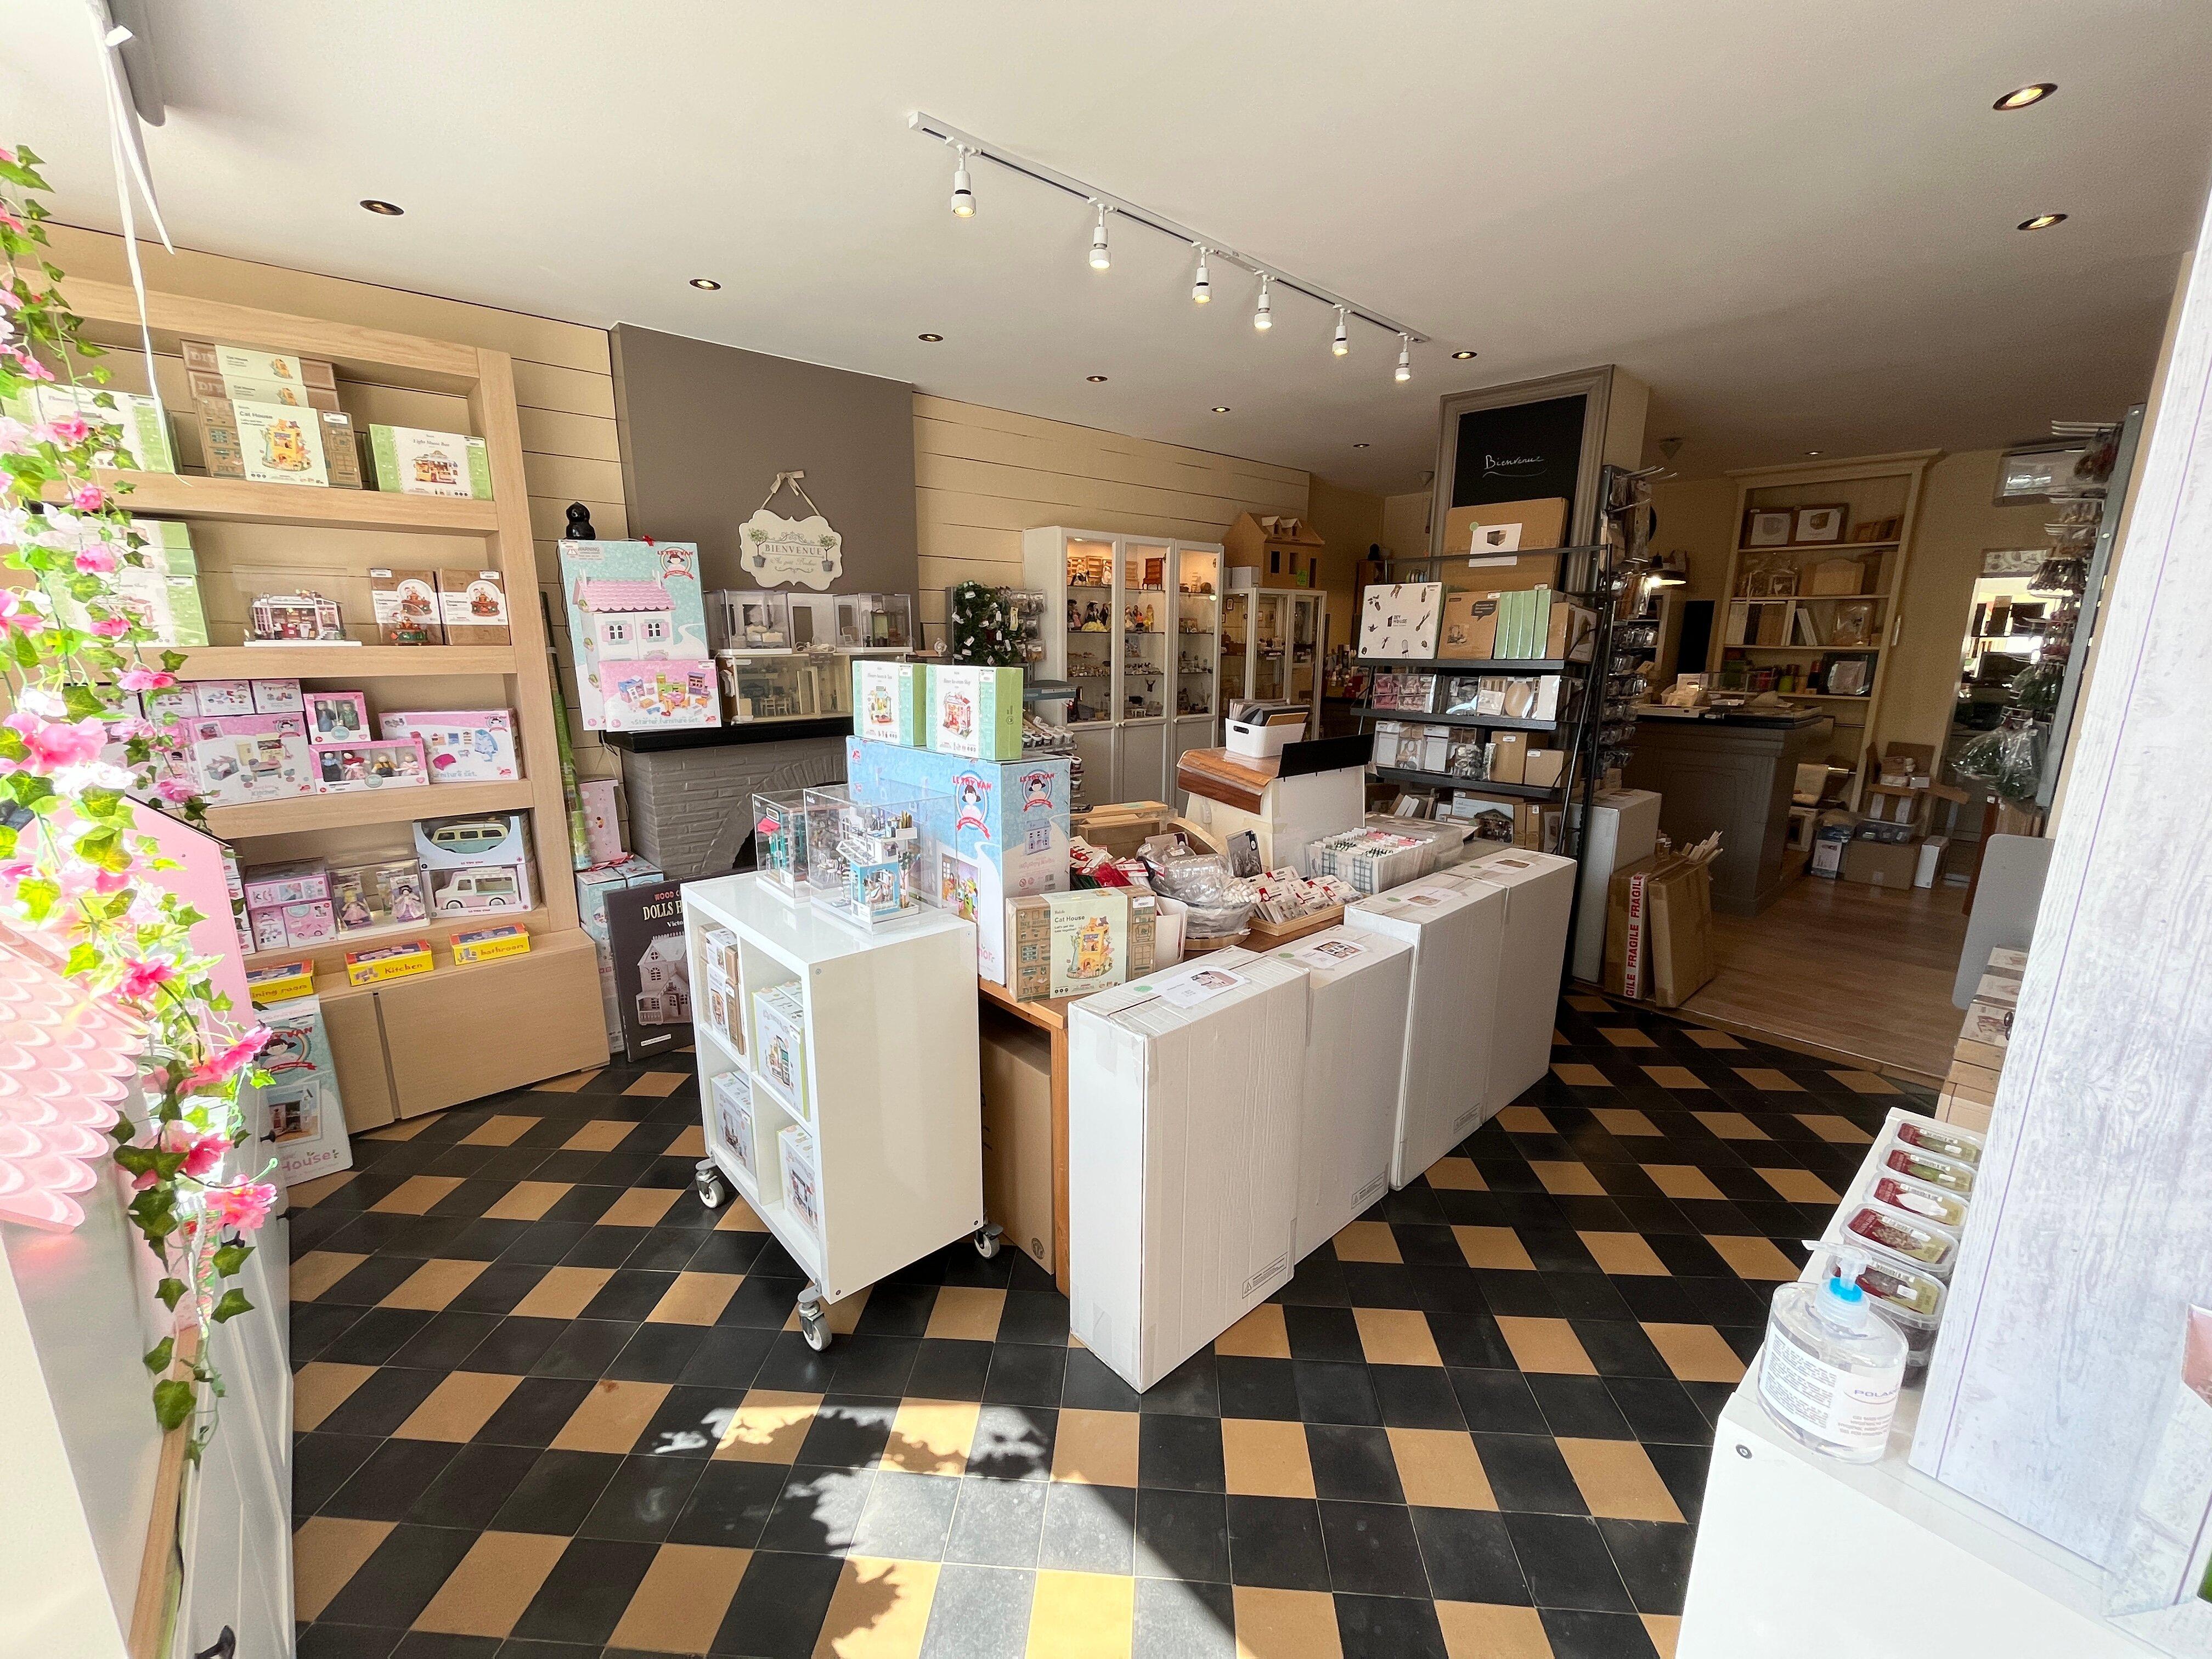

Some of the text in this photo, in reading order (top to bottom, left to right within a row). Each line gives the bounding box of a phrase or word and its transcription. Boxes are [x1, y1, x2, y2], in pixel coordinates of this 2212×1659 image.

[1483, 455, 1544, 470] Bienvenue
[765, 544, 822, 556] BIENVENUE
[952, 776, 960, 784] LE
[961, 777, 975, 786] TOY
[654, 891, 674, 901] WOOD
[642, 902, 674, 921] DOLLS
[1626, 874, 1643, 997] GILE FRAGILE FRAGILE
[480, 943, 524, 957] bathroom
[384, 962, 423, 975] Kitchen
[252, 984, 307, 999] ining room
[1023, 985, 1040, 995] DIY
